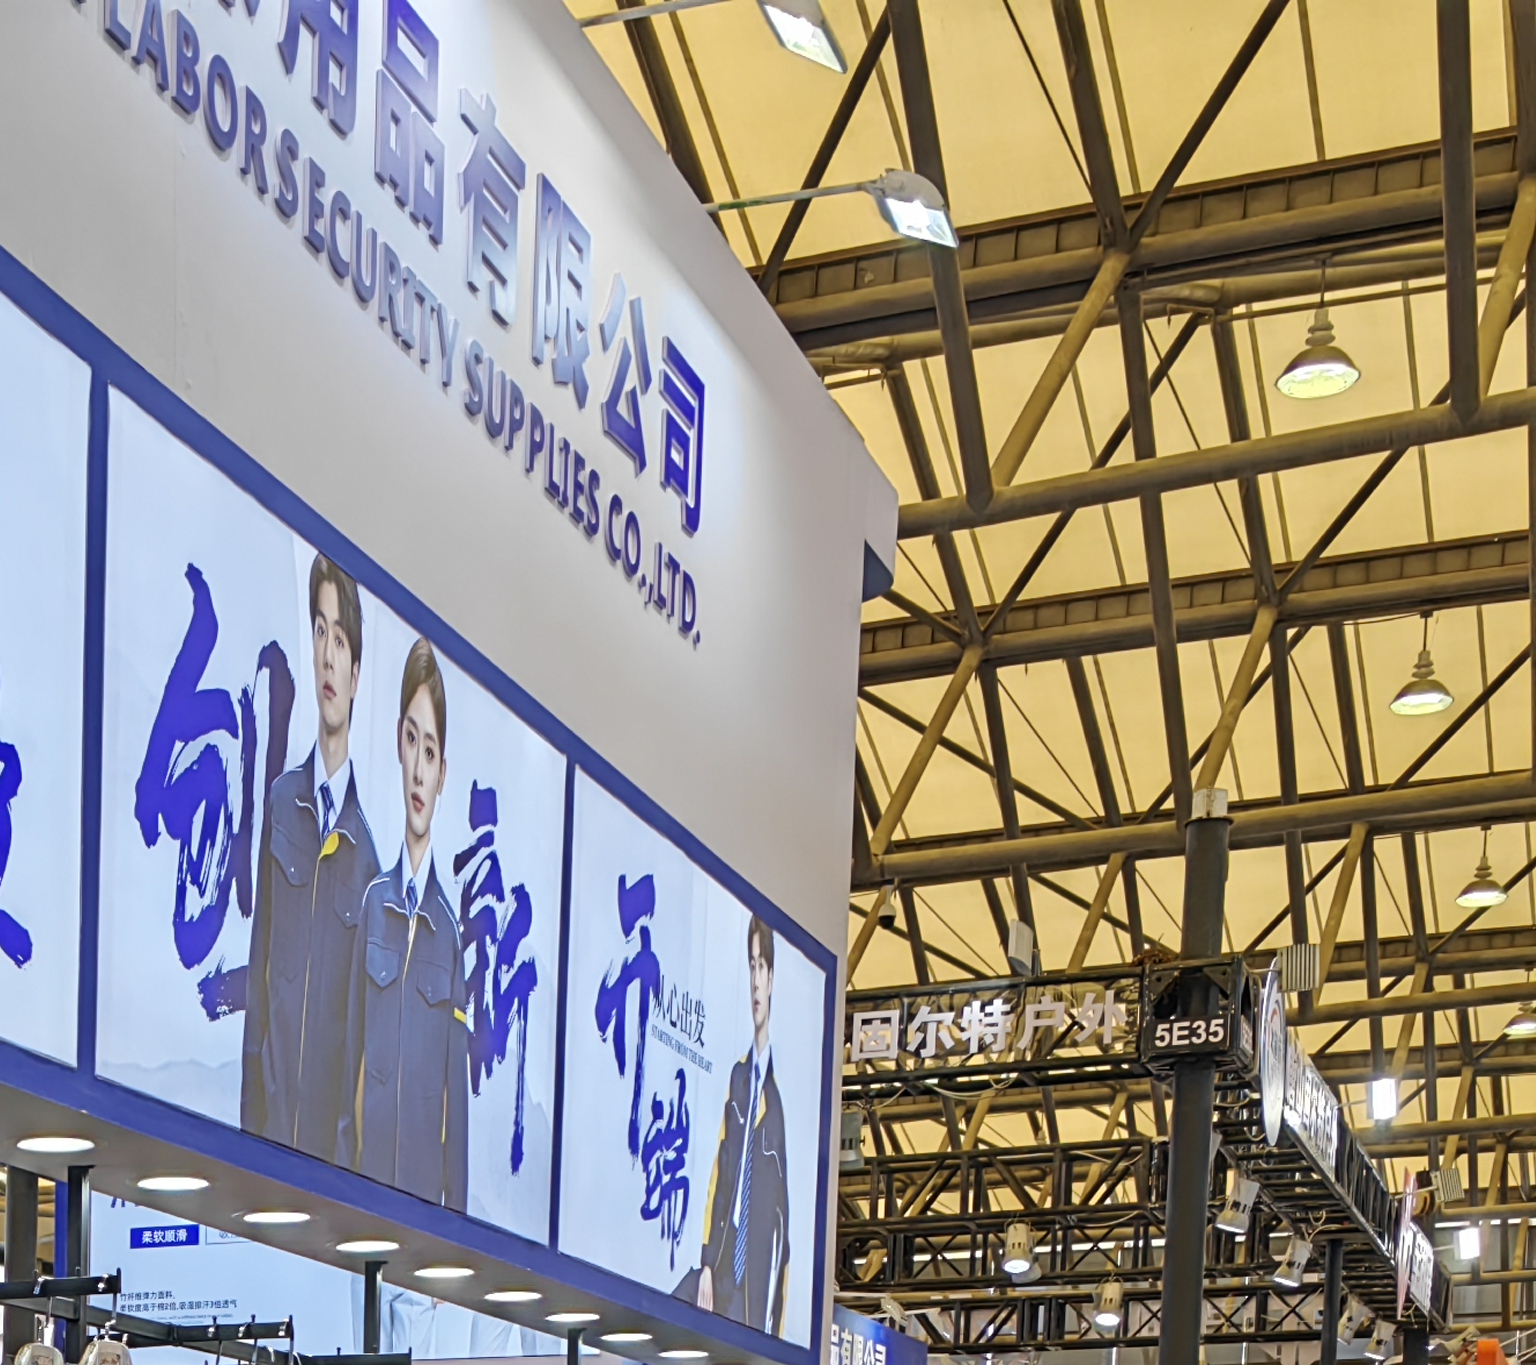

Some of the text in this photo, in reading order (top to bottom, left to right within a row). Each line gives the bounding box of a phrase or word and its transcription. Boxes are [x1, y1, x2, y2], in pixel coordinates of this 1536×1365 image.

[220, 0, 705, 535] 用品有限公司
[103, 0, 701, 645] LABOR SECURITY SUPPLIES CO.,LTD.
[652, 974, 706, 1049] 从心出发
[851, 989, 1128, 1063] 固尔特户外
[1154, 1017, 1226, 1048] 5E35
[141, 1229, 188, 1244] 柔软顺滑
